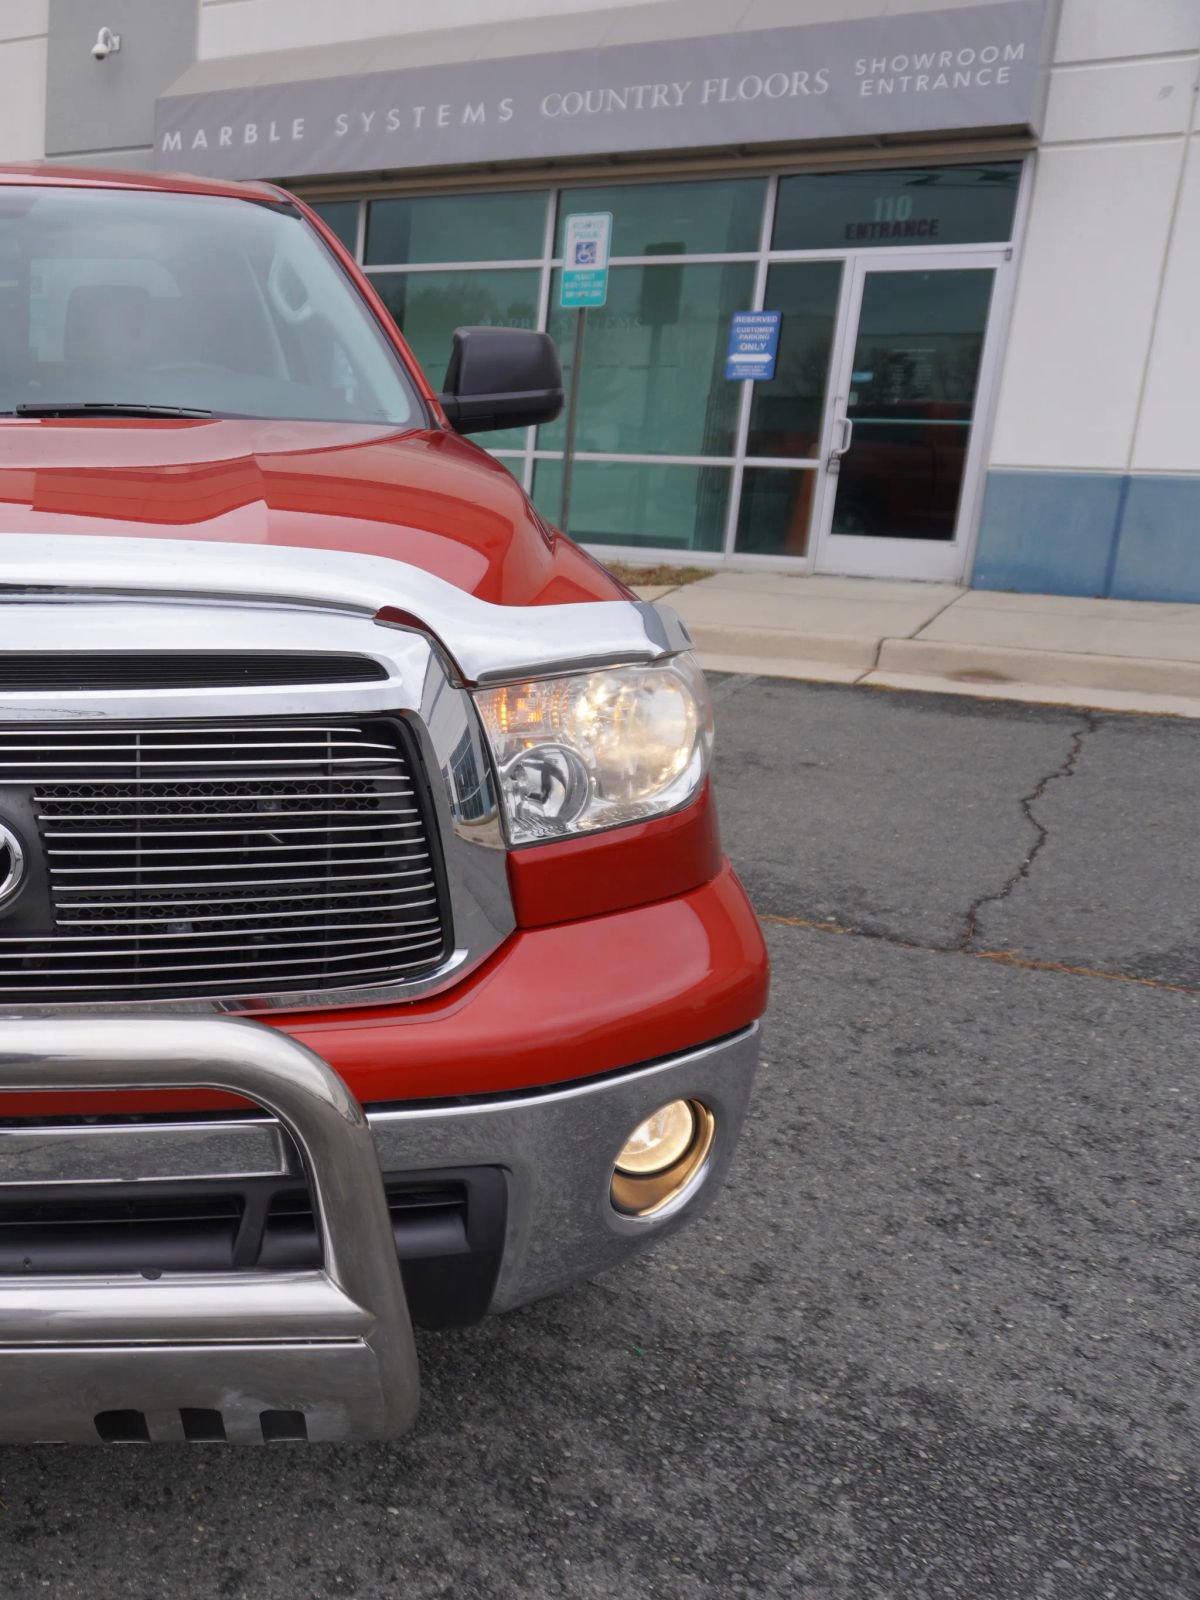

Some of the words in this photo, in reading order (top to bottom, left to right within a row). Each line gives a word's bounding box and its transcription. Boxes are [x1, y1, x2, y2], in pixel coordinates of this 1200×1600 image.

[854, 43, 1024, 76] SHOWROOM
[860, 67, 1011, 96] ENTRANCE
[162, 118, 305, 152] MARBLE
[335, 98, 513, 136] SYSTEMS
[540, 81, 691, 117] COUNTRY
[700, 68, 830, 104] FLOORS
[874, 195, 913, 221] 110
[844, 218, 940, 240] ENTRANCE
[734, 315, 778, 323] RESERVED
[740, 342, 767, 351] ONLY
